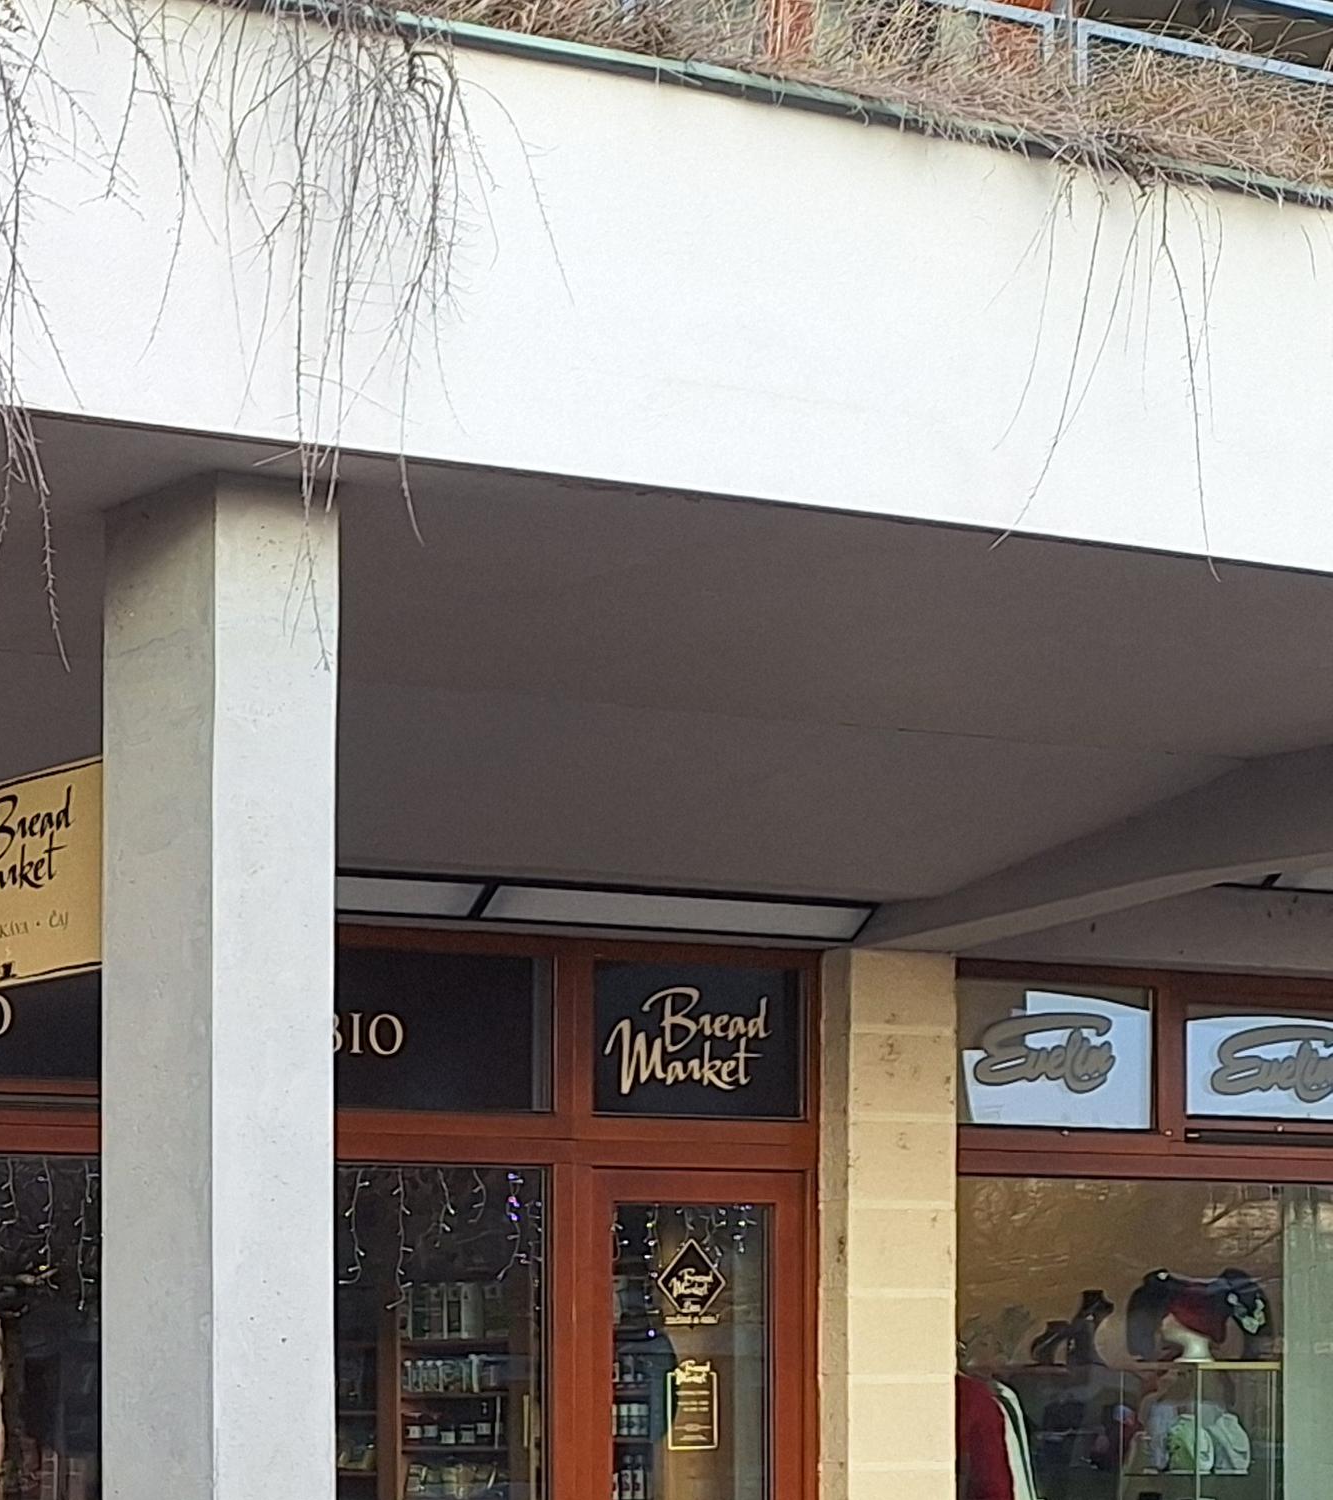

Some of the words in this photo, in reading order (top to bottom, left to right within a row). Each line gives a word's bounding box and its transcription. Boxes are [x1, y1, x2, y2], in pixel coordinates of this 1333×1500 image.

[49, 909, 70, 930] ČAJ
[642, 986, 772, 1052] Bread
[603, 1018, 764, 1095] Market
